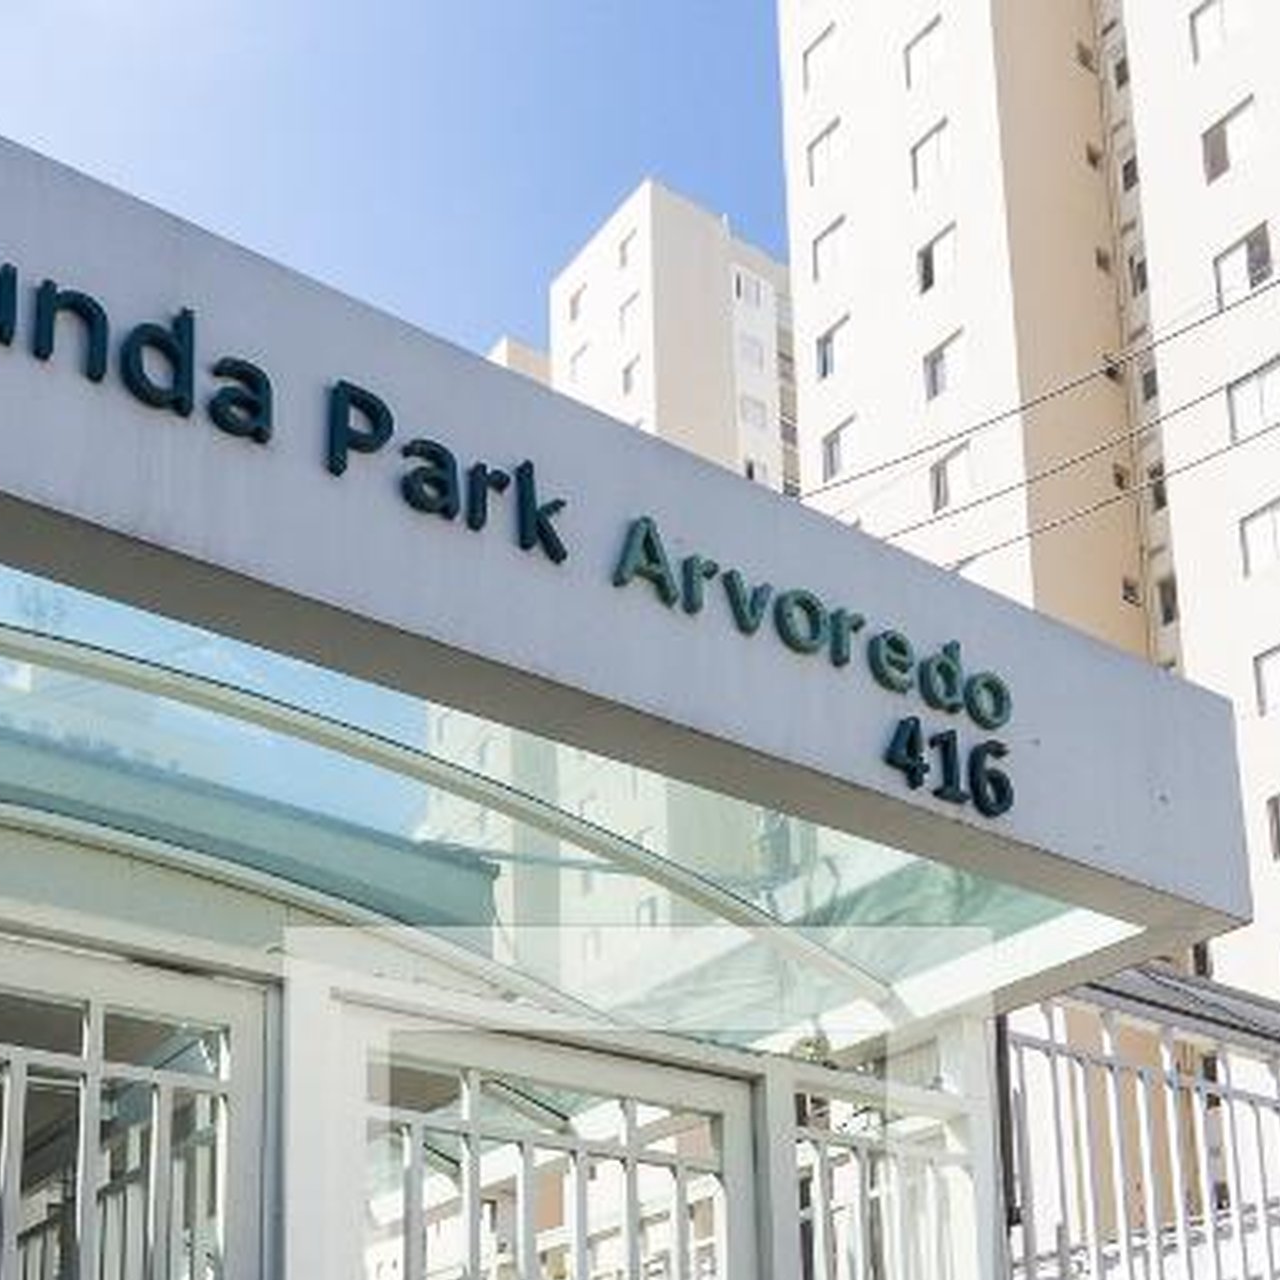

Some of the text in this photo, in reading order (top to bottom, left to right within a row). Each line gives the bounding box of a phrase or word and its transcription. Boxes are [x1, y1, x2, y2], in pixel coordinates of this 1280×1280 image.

[324, 377, 569, 565] Park
[612, 514, 1014, 732] Arvoredo
[882, 714, 1016, 820] 416
